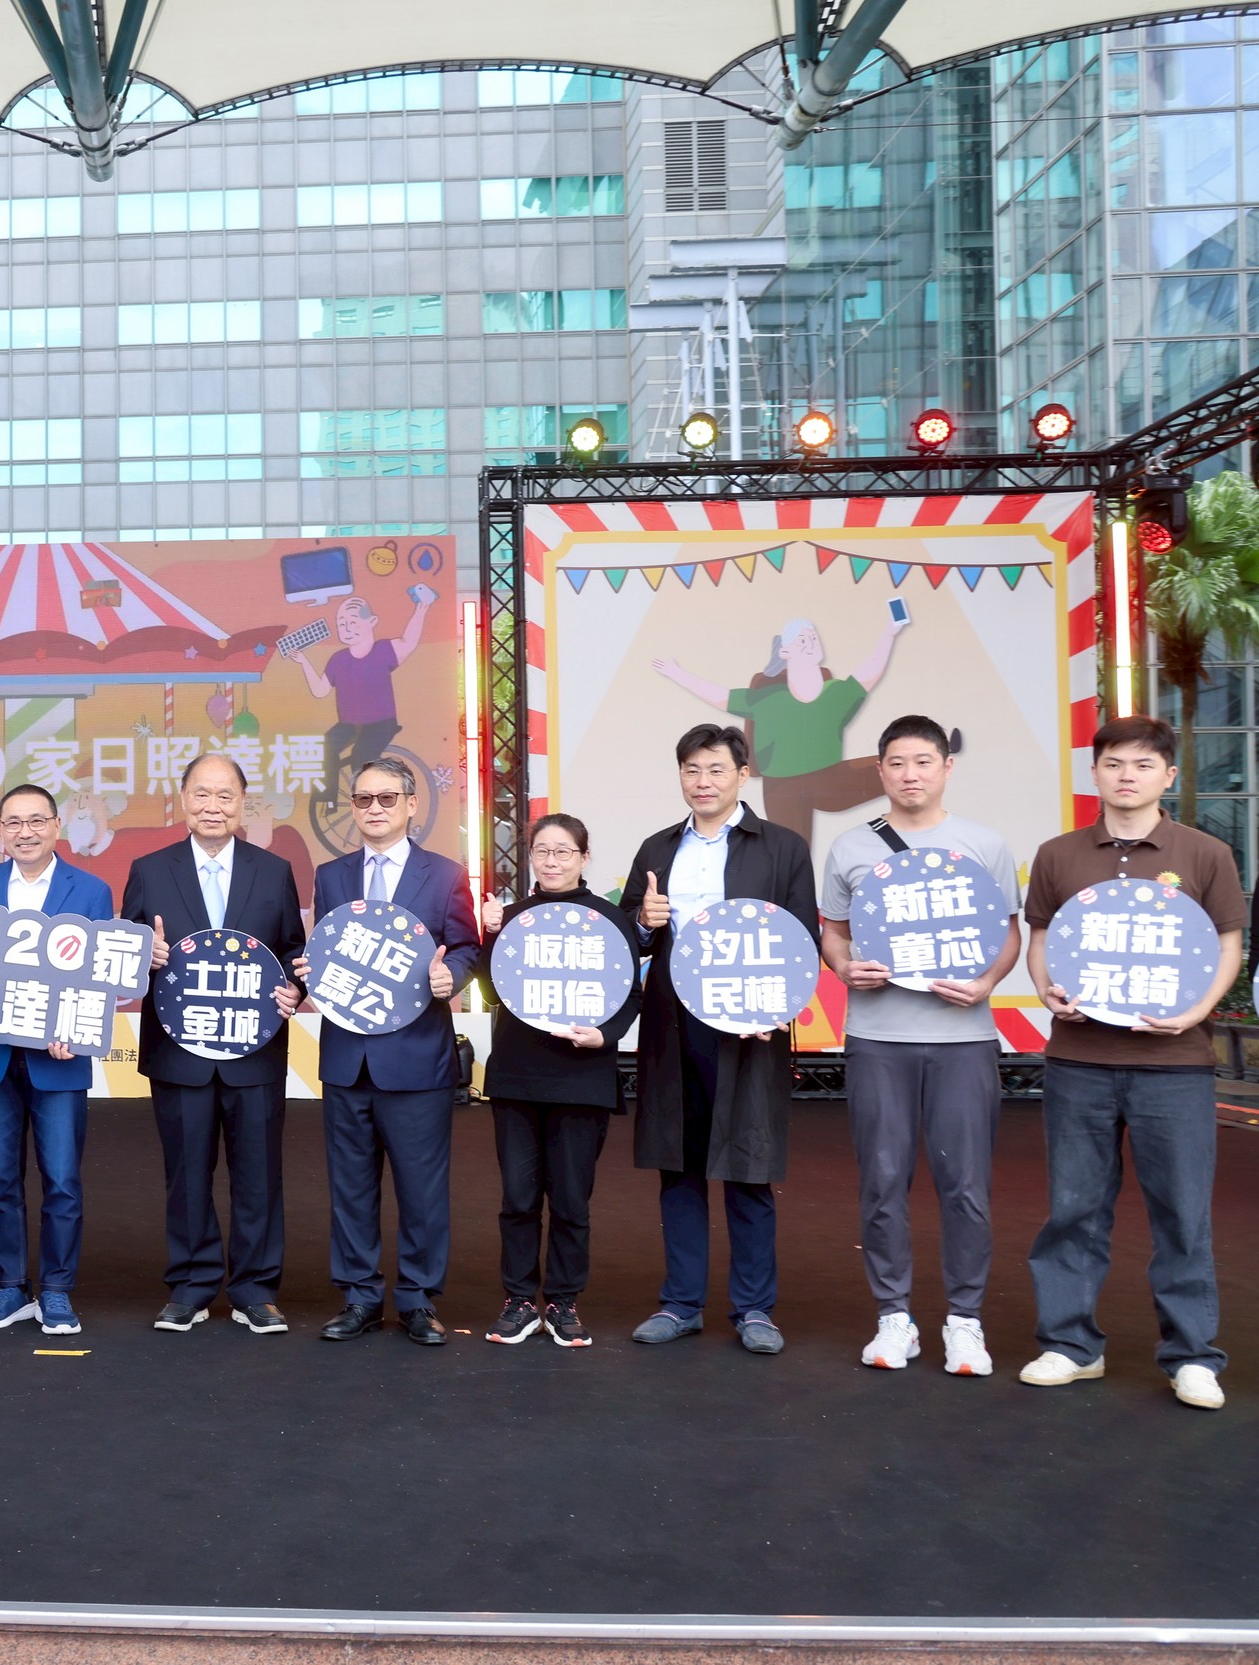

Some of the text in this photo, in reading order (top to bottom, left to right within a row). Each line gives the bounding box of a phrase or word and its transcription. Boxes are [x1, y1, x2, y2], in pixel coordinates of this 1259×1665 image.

[882, 875, 978, 923] 新莊
[334, 920, 418, 983] 新店
[523, 933, 606, 971] 板橋
[699, 927, 786, 967] 汐止
[889, 926, 986, 974] 童芯
[1079, 911, 1183, 956] 新莊
[183, 960, 262, 1000] 土城
[314, 961, 395, 1025] 馬公
[522, 978, 606, 1017] 明倫
[701, 975, 789, 1014] 民權
[1077, 962, 1180, 1007] 永錡
[181, 1005, 260, 1045] 金城
